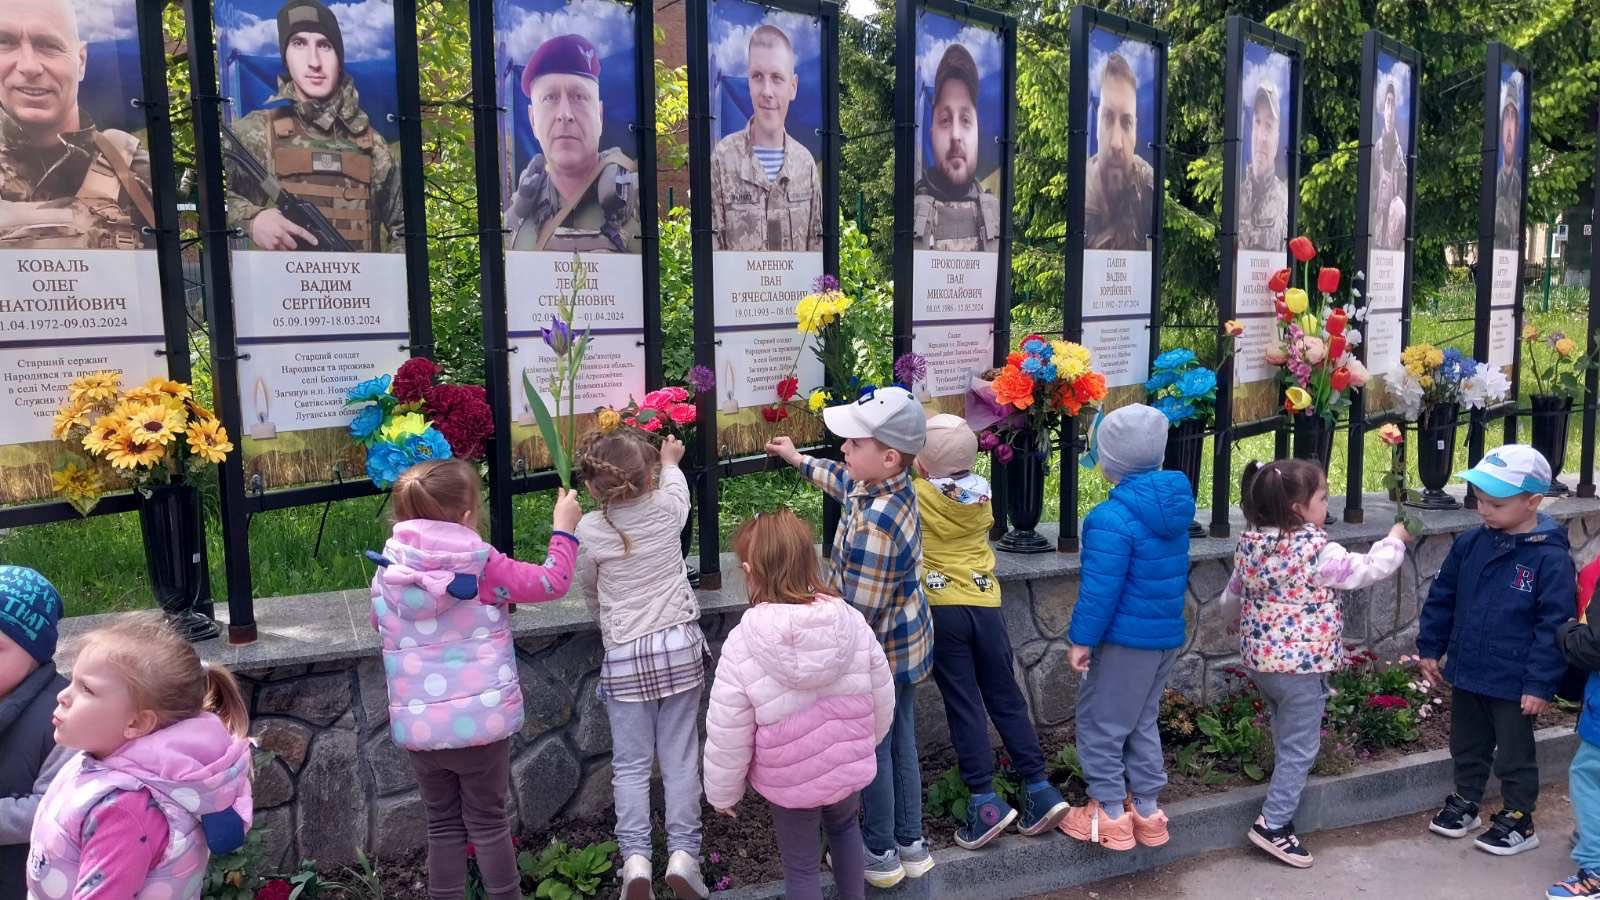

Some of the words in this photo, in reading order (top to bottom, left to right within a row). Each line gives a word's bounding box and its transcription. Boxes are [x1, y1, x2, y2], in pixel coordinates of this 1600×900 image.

[17, 259, 89, 273] КОВАЛЬ
[285, 261, 361, 275] САРАНЧУК
[746, 260, 794, 271] МАРЕНЮК
[931, 258, 980, 269] ПРОКОПОВИЧ
[760, 276, 782, 287] ІВАН
[946, 273, 964, 284] ІВАН
[32, 279, 79, 292] ОЛЕГ
[300, 279, 352, 294] ВАДИМ
[555, 278, 598, 291] ЛЕОІД
[731, 291, 808, 303] В'ЯЧЕСЛАВОВИЧ
[927, 287, 983, 299] МИКОЛАЙОВИЧ
[282, 295, 371, 311] СЕРГІЙОВИЧ
[273, 315, 381, 328] 05.09.1997-18.03.2024
[17, 358, 65, 368] Старший
[67, 356, 109, 367] сержант
[294, 352, 332, 362] Старший
[333, 351, 360, 360] солдат
[281, 365, 325, 374] Народився
[338, 363, 375, 372] проживав
[4, 372, 60, 382] Народився
[62, 371, 74, 379] та
[301, 375, 318, 384] селі
[17, 383, 38, 394] селі
[274, 388, 309, 399] Загинув
[14, 397, 56, 408] Служив
[295, 411, 337, 421] Луганська
[1510, 563, 1535, 593] R
[4, 595, 50, 631] THAT
